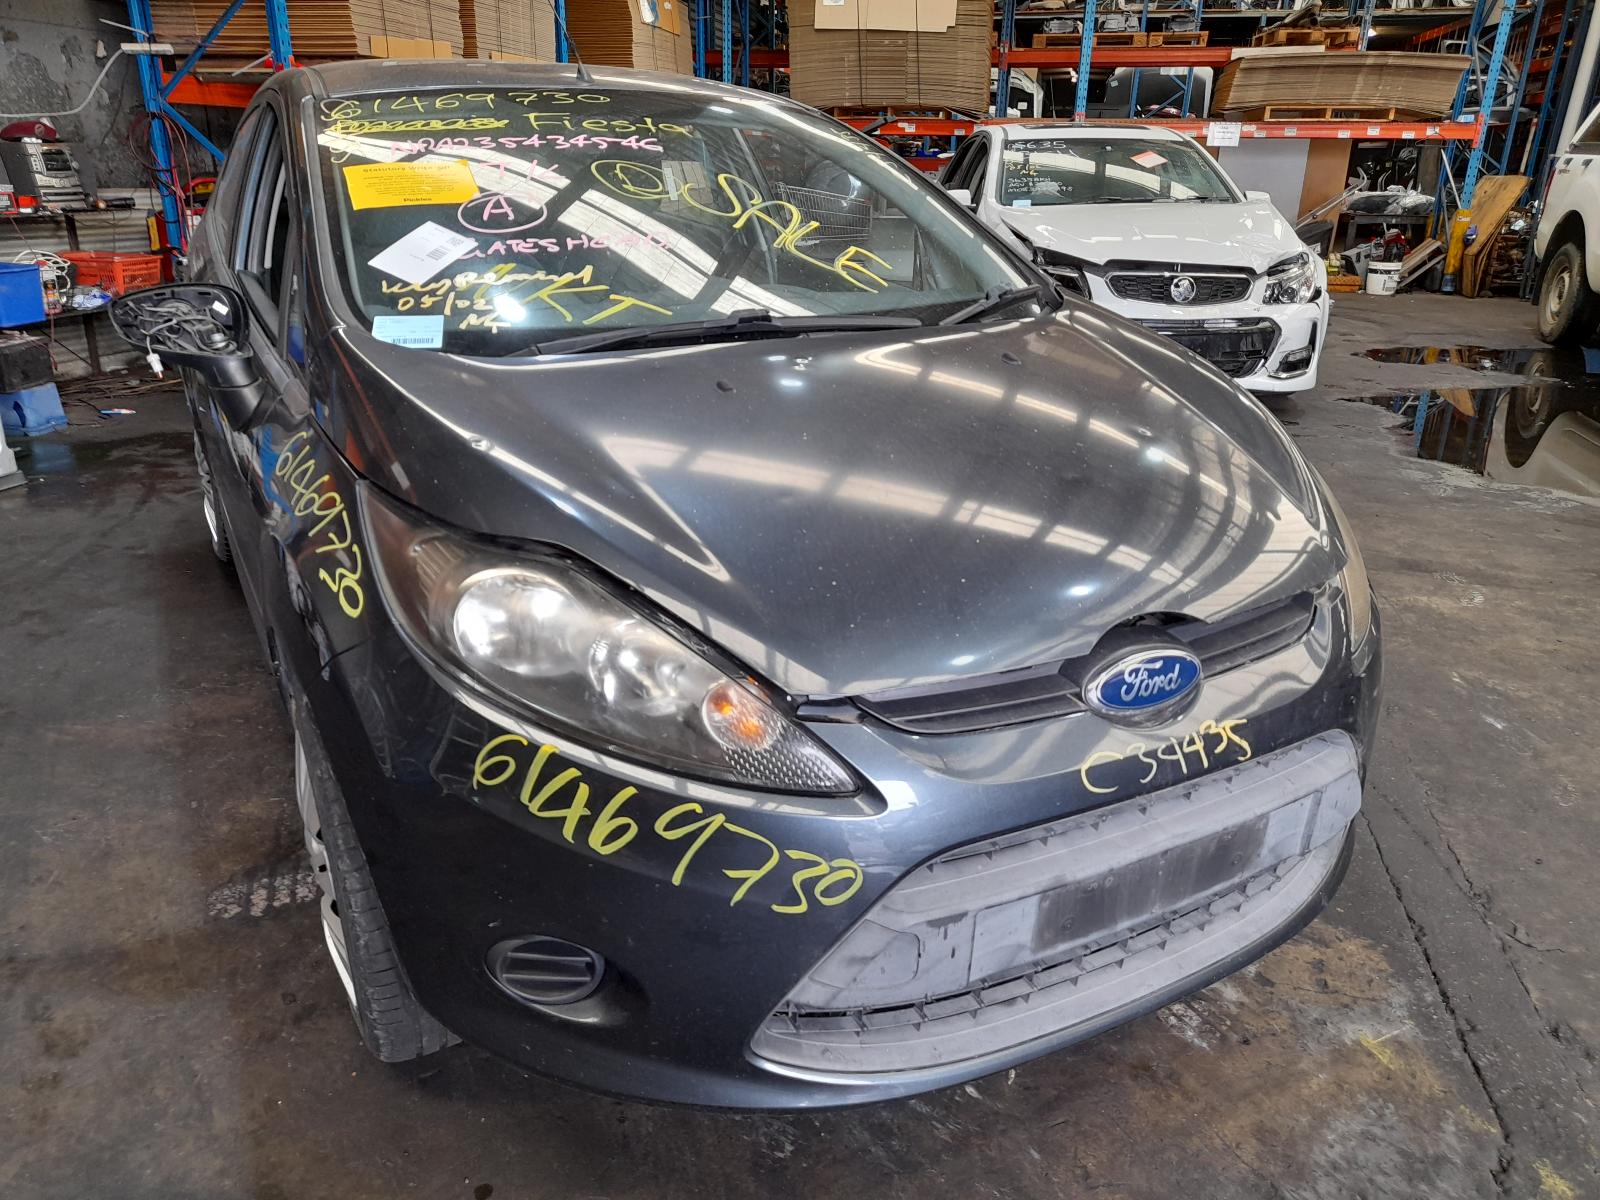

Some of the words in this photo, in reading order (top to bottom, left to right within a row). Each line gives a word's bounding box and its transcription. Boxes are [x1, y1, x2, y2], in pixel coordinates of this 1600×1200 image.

[331, 91, 611, 119] 61469730
[522, 112, 693, 138] Fiesta
[482, 194, 515, 221] A
[276, 431, 364, 618] 61469730
[1121, 659, 1182, 702] Ford
[473, 734, 864, 914] 61469730
